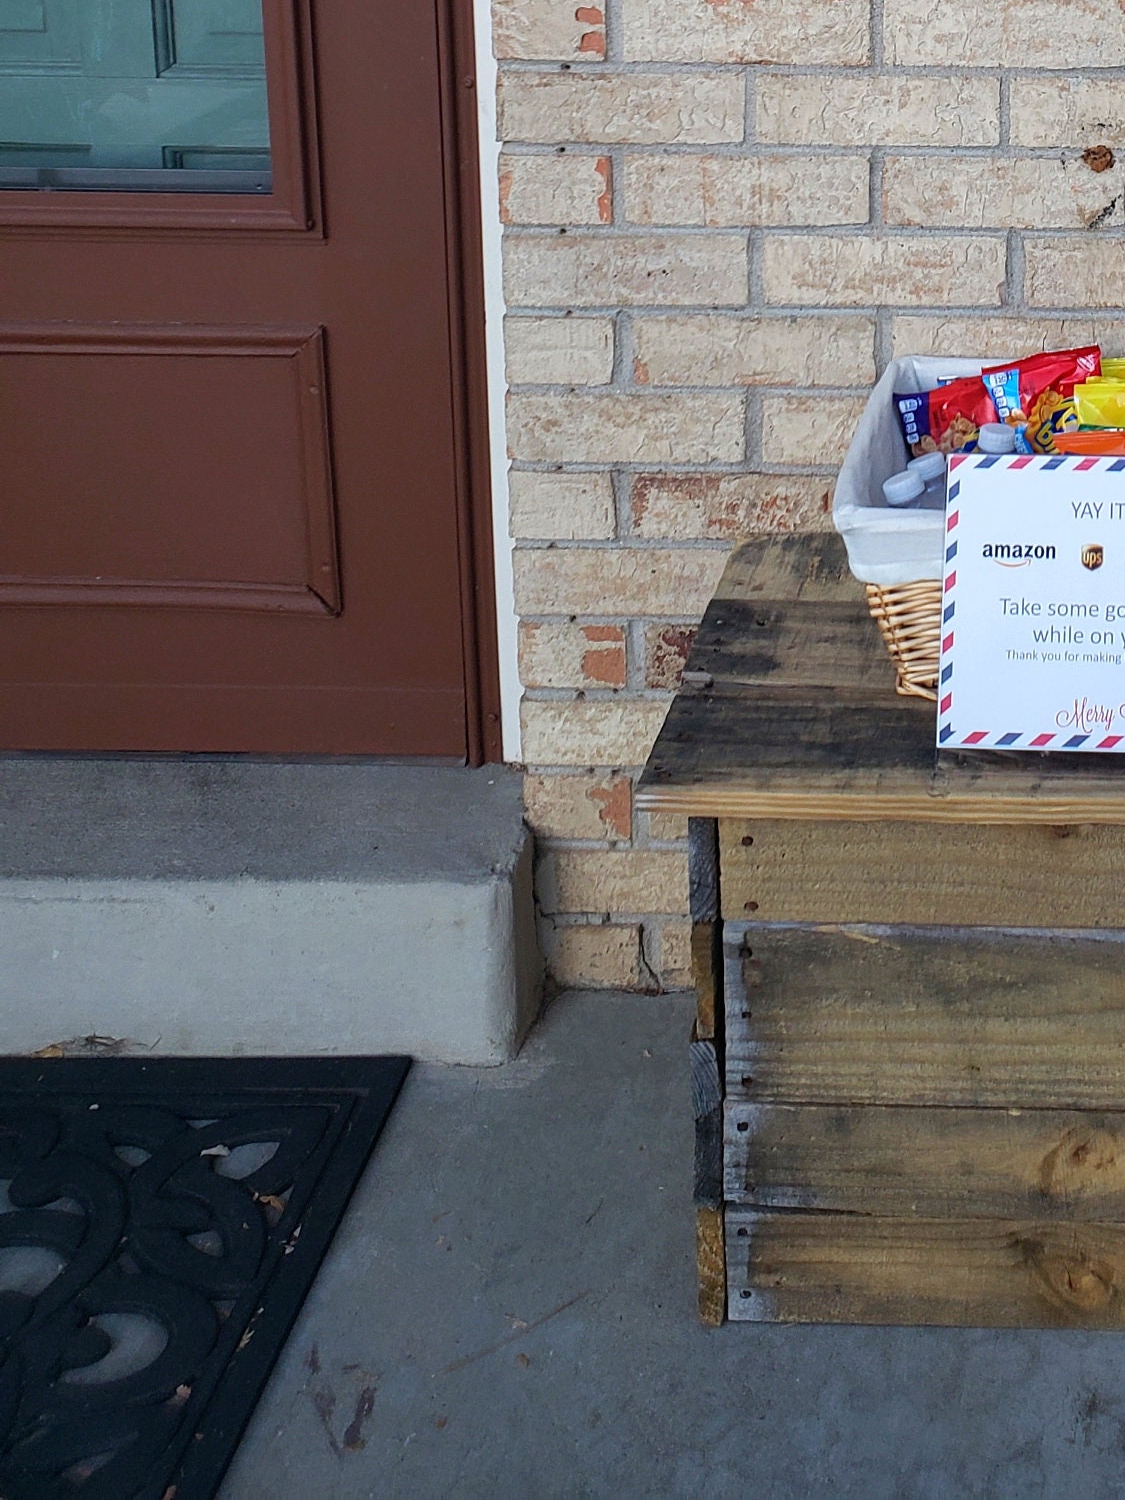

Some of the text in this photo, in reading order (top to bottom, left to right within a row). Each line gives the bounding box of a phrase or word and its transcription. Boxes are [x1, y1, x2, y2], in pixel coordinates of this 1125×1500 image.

[1071, 501, 1103, 520] YAY
[982, 543, 1056, 560] amazon
[1000, 597, 1042, 617] Take
[1048, 602, 1099, 618] some
[1032, 625, 1084, 644] while
[1090, 630, 1114, 645] on
[1005, 649, 1038, 661] Thank
[1041, 652, 1061, 663] you
[1064, 650, 1080, 662] for
[1082, 651, 1122, 665] making
[1055, 697, 1116, 733] Merry
